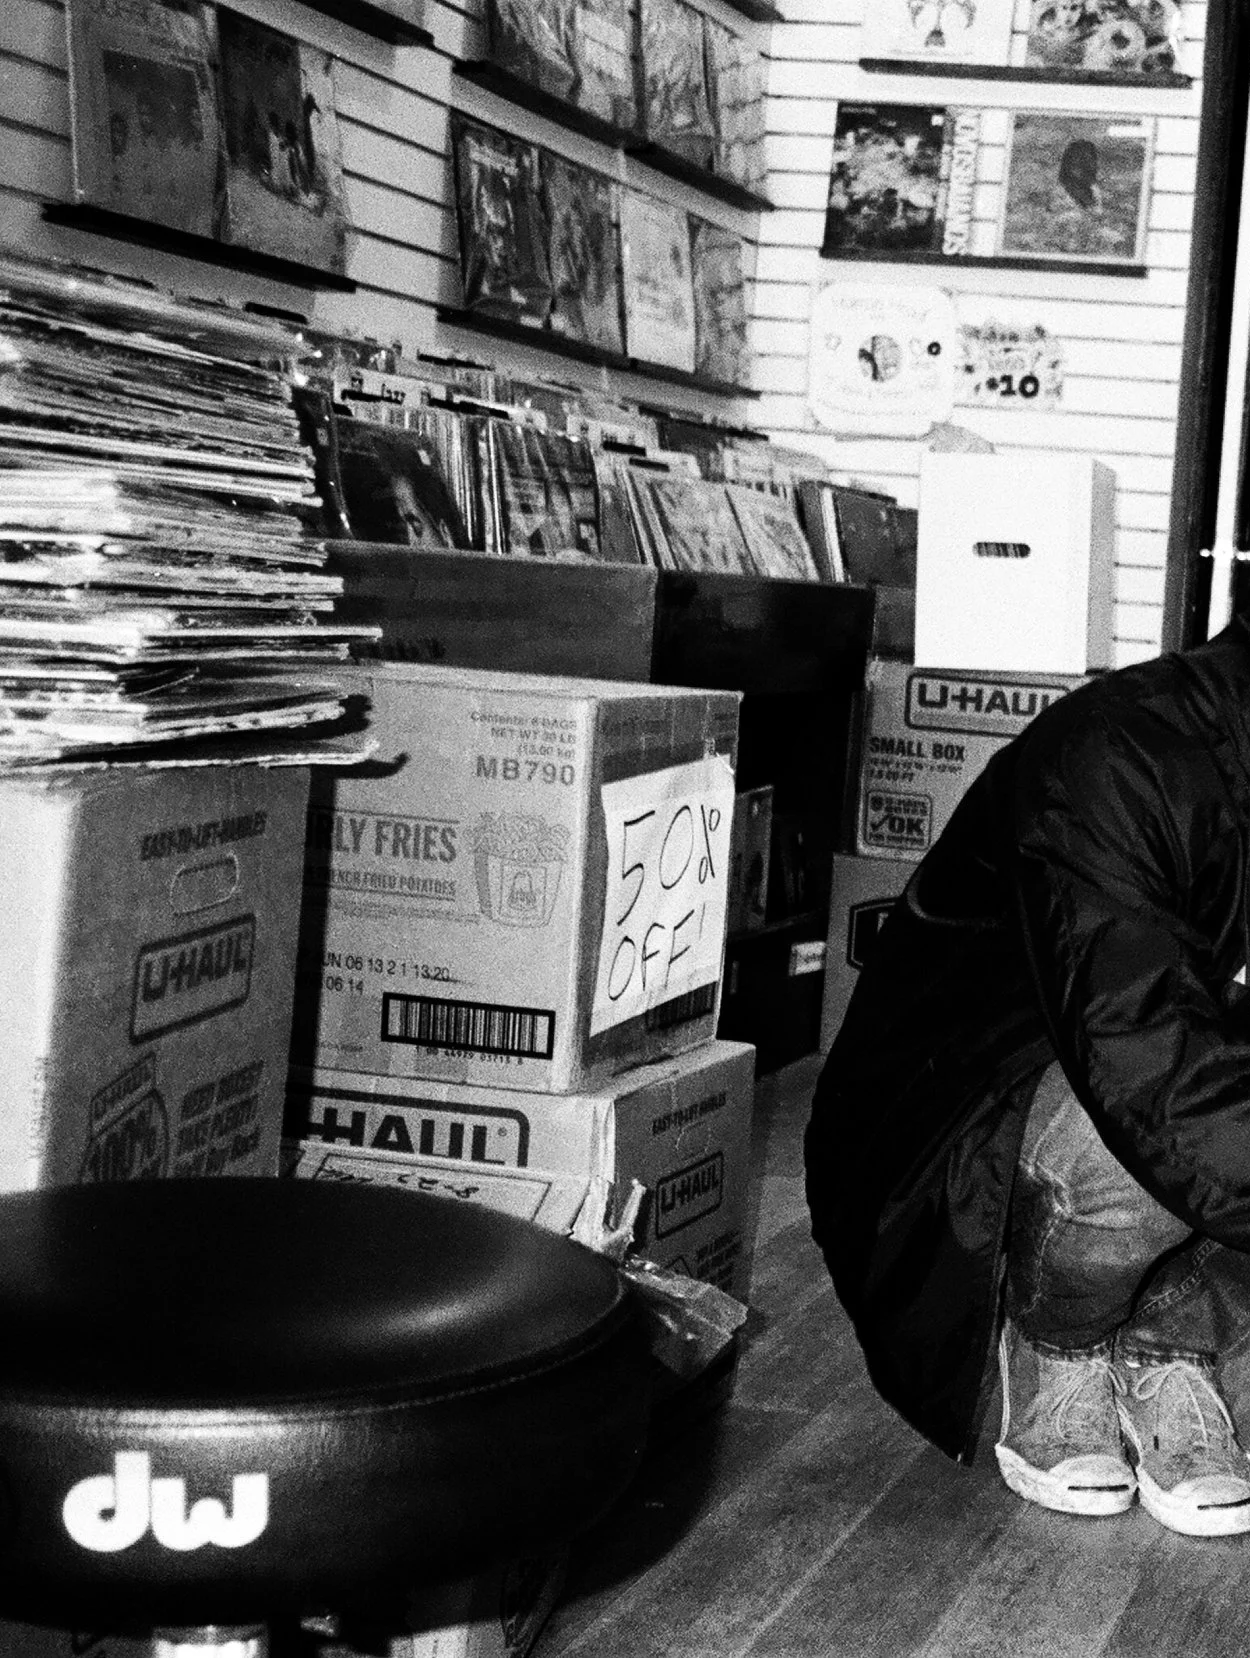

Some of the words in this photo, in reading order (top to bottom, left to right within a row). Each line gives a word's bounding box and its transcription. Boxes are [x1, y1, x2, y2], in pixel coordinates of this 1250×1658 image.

[869, 737, 925, 759] SMALL
[932, 742, 965, 763] BOX
[475, 754, 576, 786] MB790
[374, 819, 457, 863] FRIES
[888, 815, 925, 836] OK
[617, 804, 720, 926] 50%
[400, 875, 457, 896] POTATOES
[142, 930, 248, 1003] U-HAUL
[345, 955, 363, 971] 06
[368, 958, 384, 973] 13
[388, 961, 396, 975] 2
[326, 975, 343, 991] 06
[348, 978, 364, 994] 14
[303, 1106, 505, 1166] -HAUL
[661, 1163, 719, 1215] U-HAUL
[62, 1449, 270, 1553] dw
